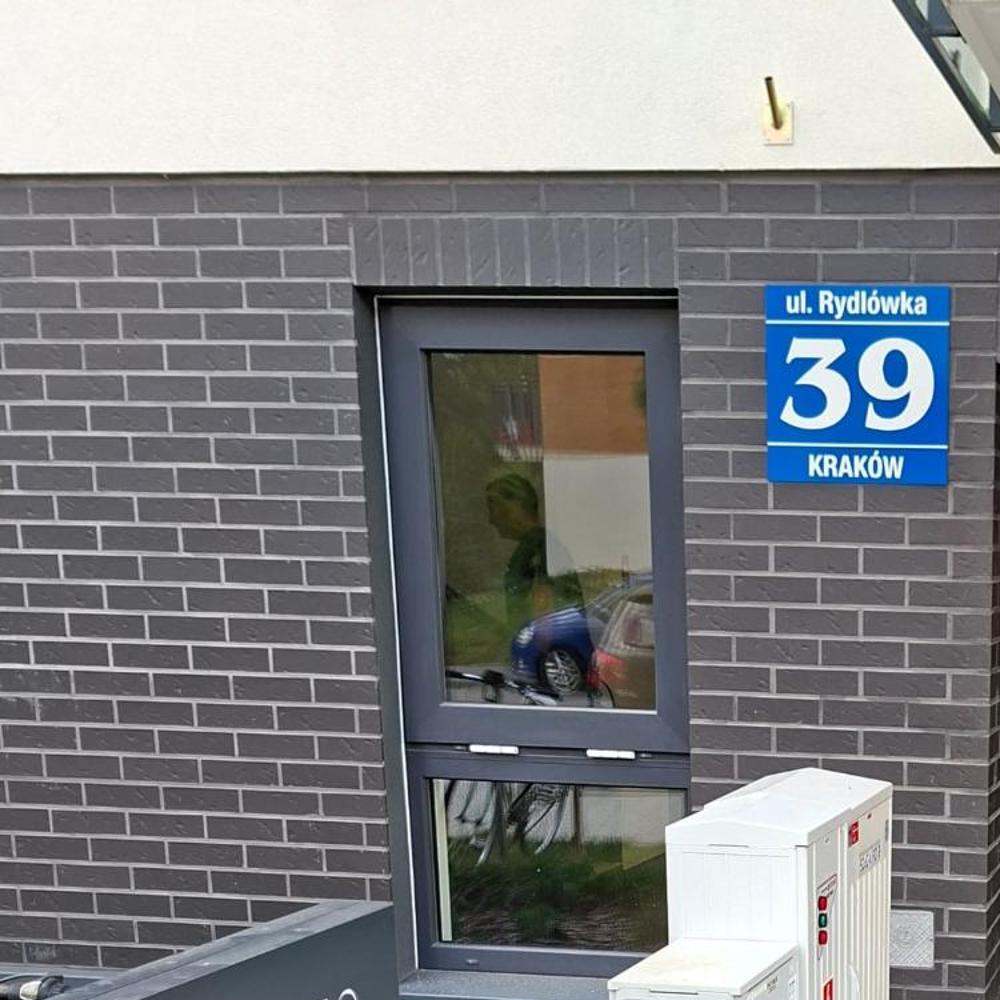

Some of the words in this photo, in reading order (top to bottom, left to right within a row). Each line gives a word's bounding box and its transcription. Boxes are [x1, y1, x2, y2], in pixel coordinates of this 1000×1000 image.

[786, 290, 812, 314] ul.
[819, 290, 928, 319] Rydlówka
[780, 337, 935, 431] 39
[808, 450, 905, 479] KRAKÓW
